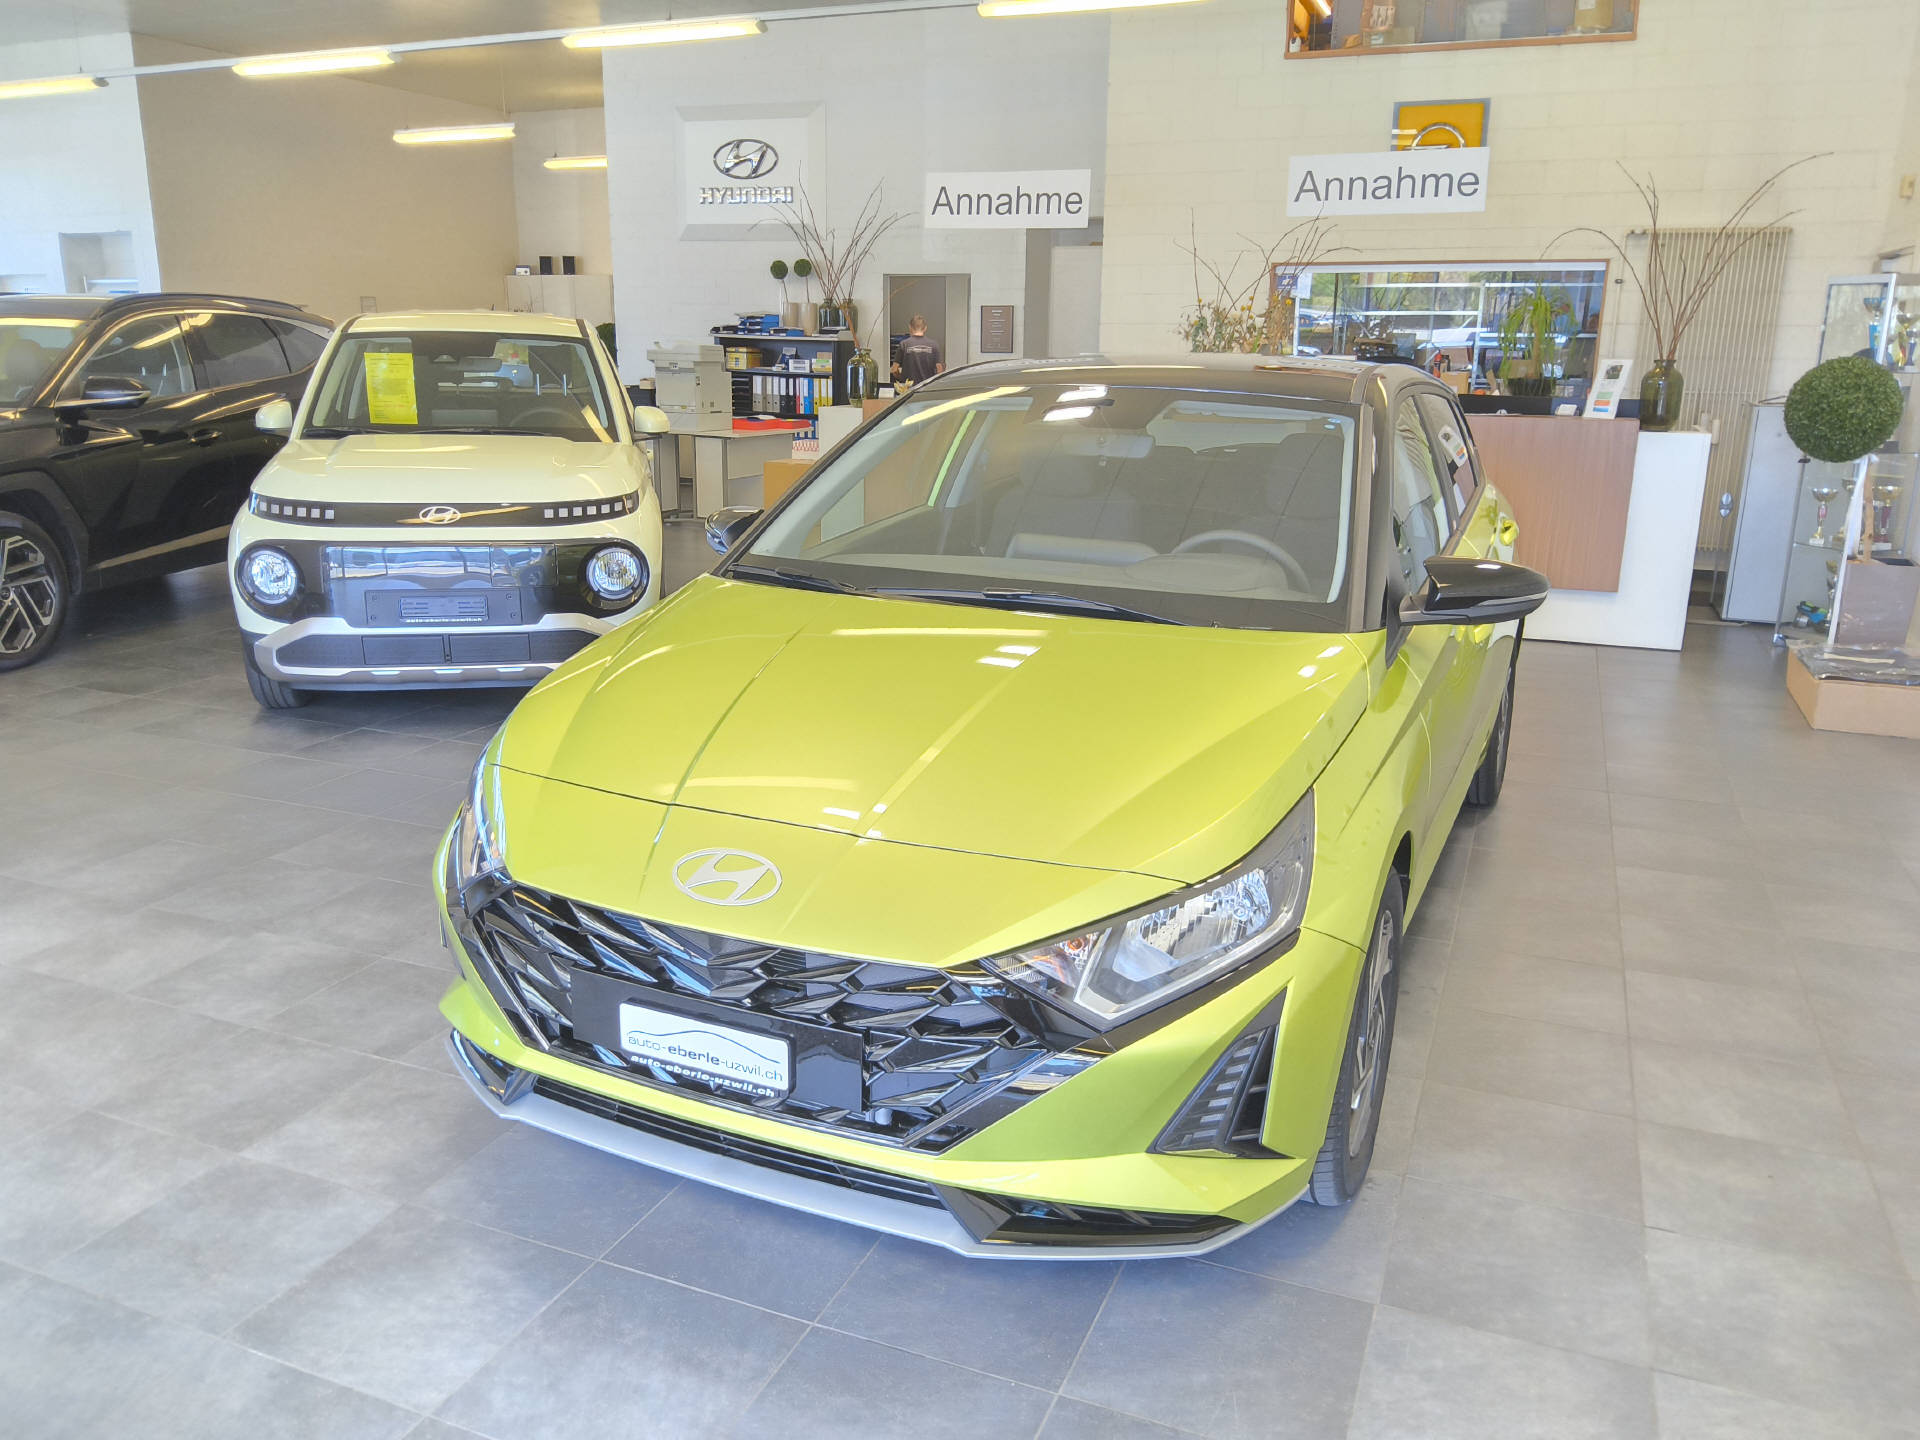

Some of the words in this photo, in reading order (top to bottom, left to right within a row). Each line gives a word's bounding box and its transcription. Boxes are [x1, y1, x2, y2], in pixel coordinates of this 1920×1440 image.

[699, 186, 793, 205] HYUNDAI
[931, 185, 1083, 216] Annahme
[1293, 166, 1480, 202] Annahme
[628, 1036, 783, 1082] auto-eberle-uzwil.ch
[631, 1055, 775, 1098] auto-eberle-uzwil.ch
